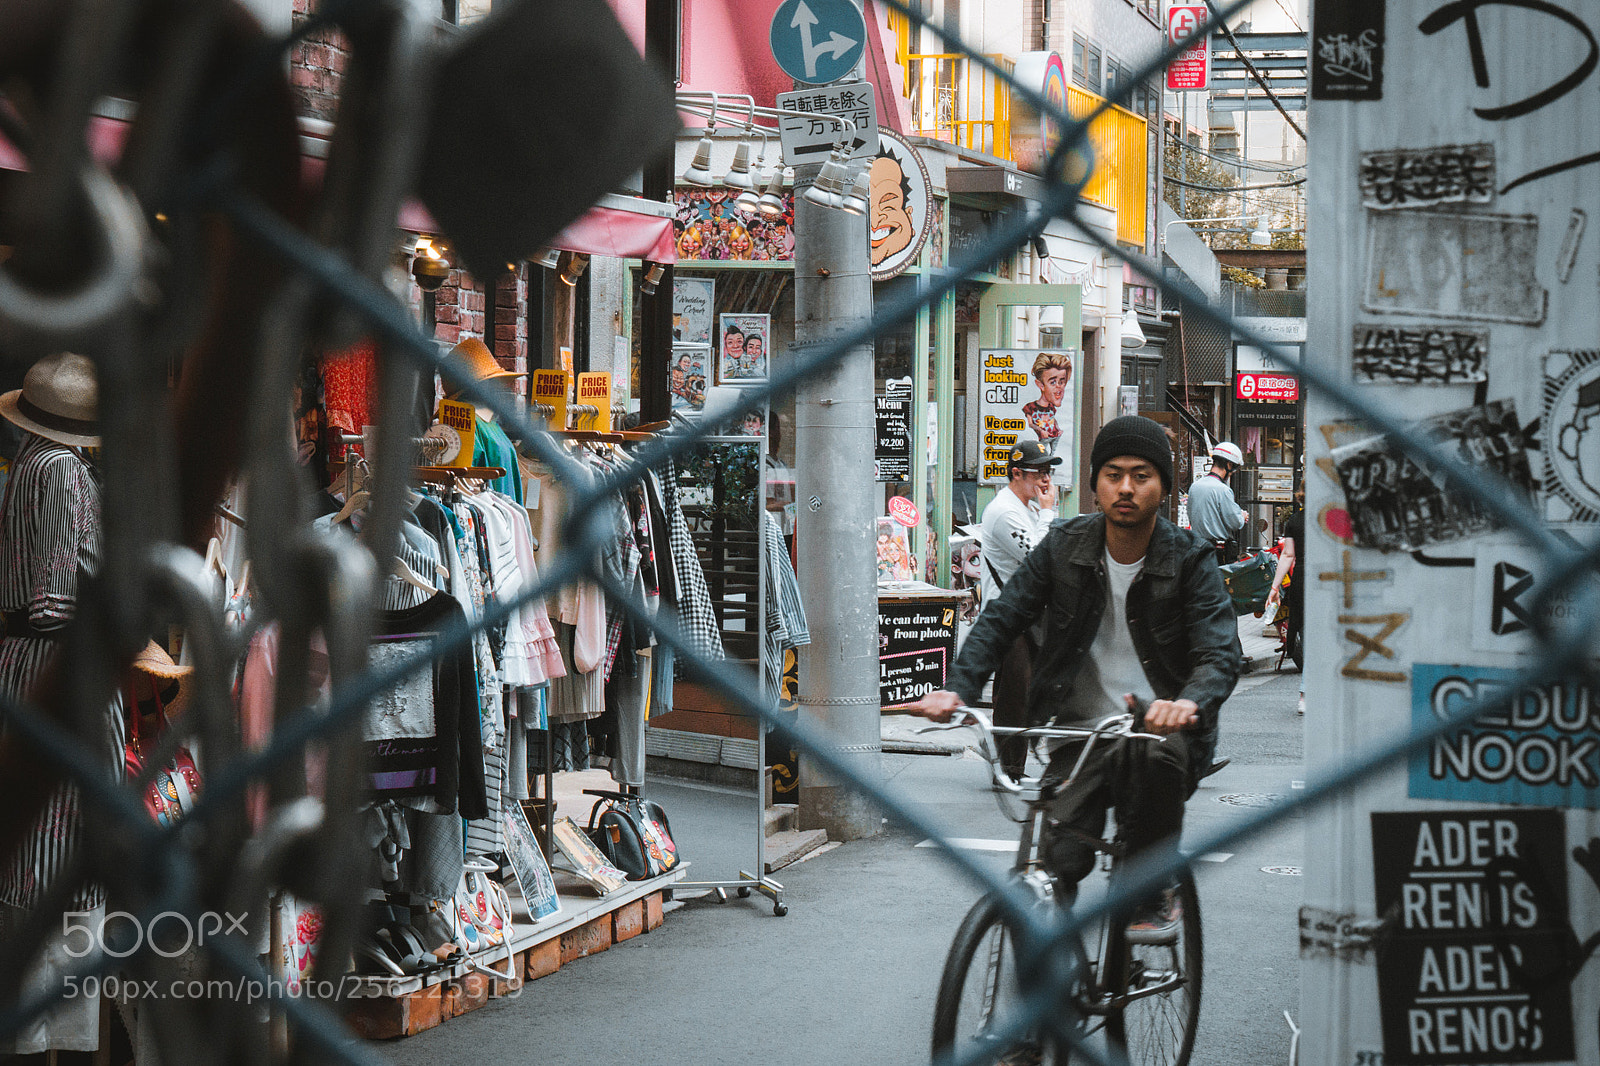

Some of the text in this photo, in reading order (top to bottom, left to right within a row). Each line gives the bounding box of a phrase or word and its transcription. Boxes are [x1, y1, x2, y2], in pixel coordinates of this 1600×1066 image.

[783, 91, 868, 113] 自転車を除く
[675, 295, 706, 307] Wedding
[683, 304, 706, 315] Corner
[984, 354, 1014, 368] Just
[538, 374, 564, 385] PRICE
[581, 376, 607, 387] PRICE
[984, 371, 1028, 386] looking
[1258, 378, 1296, 389] 原宿の母
[535, 384, 564, 395] DOWN
[581, 387, 608, 397] DOWN
[986, 386, 1018, 404] ok!!
[877, 397, 903, 409] Menu
[443, 404, 471, 419] PRICE
[442, 415, 472, 430] DOWN
[984, 415, 1026, 431] We can
[984, 431, 1018, 446] draw
[892, 616, 911, 625] can
[912, 613, 939, 625] draw
[894, 627, 951, 641] from photo.
[887, 667, 912, 678] person
[915, 657, 925, 671] 5
[924, 661, 940, 671] min
[1413, 820, 1520, 867] ADER
